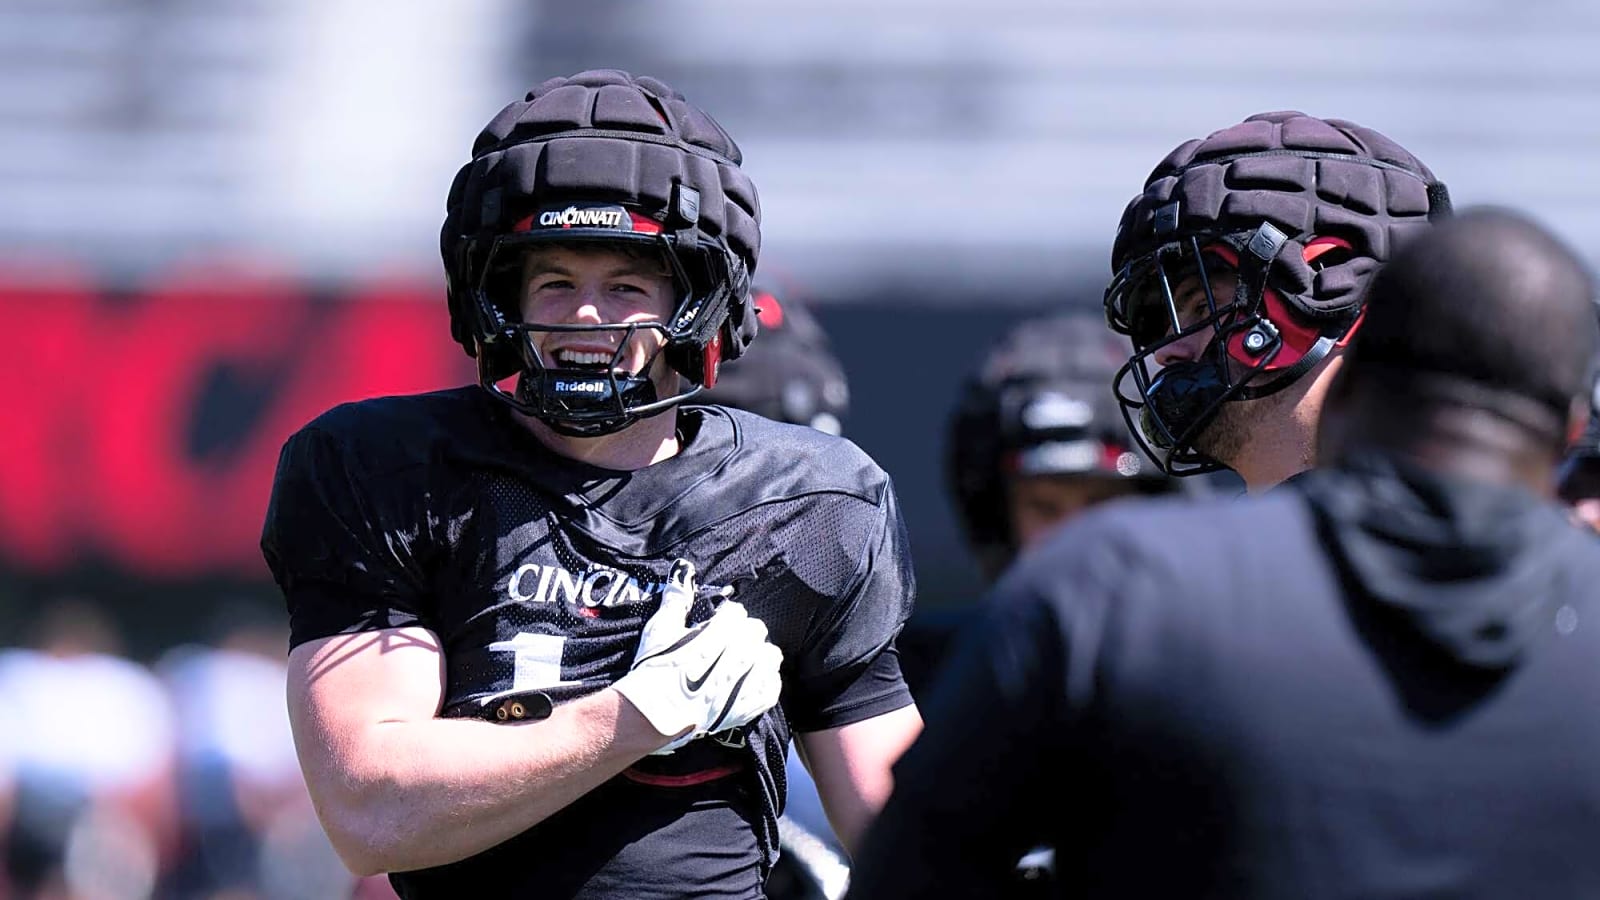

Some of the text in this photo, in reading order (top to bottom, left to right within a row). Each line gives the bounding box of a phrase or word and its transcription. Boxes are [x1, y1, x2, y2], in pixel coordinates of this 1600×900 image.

[539, 207, 622, 227] CINCINNATI
[555, 381, 604, 393] Riddell
[508, 563, 665, 607] CINCIN
